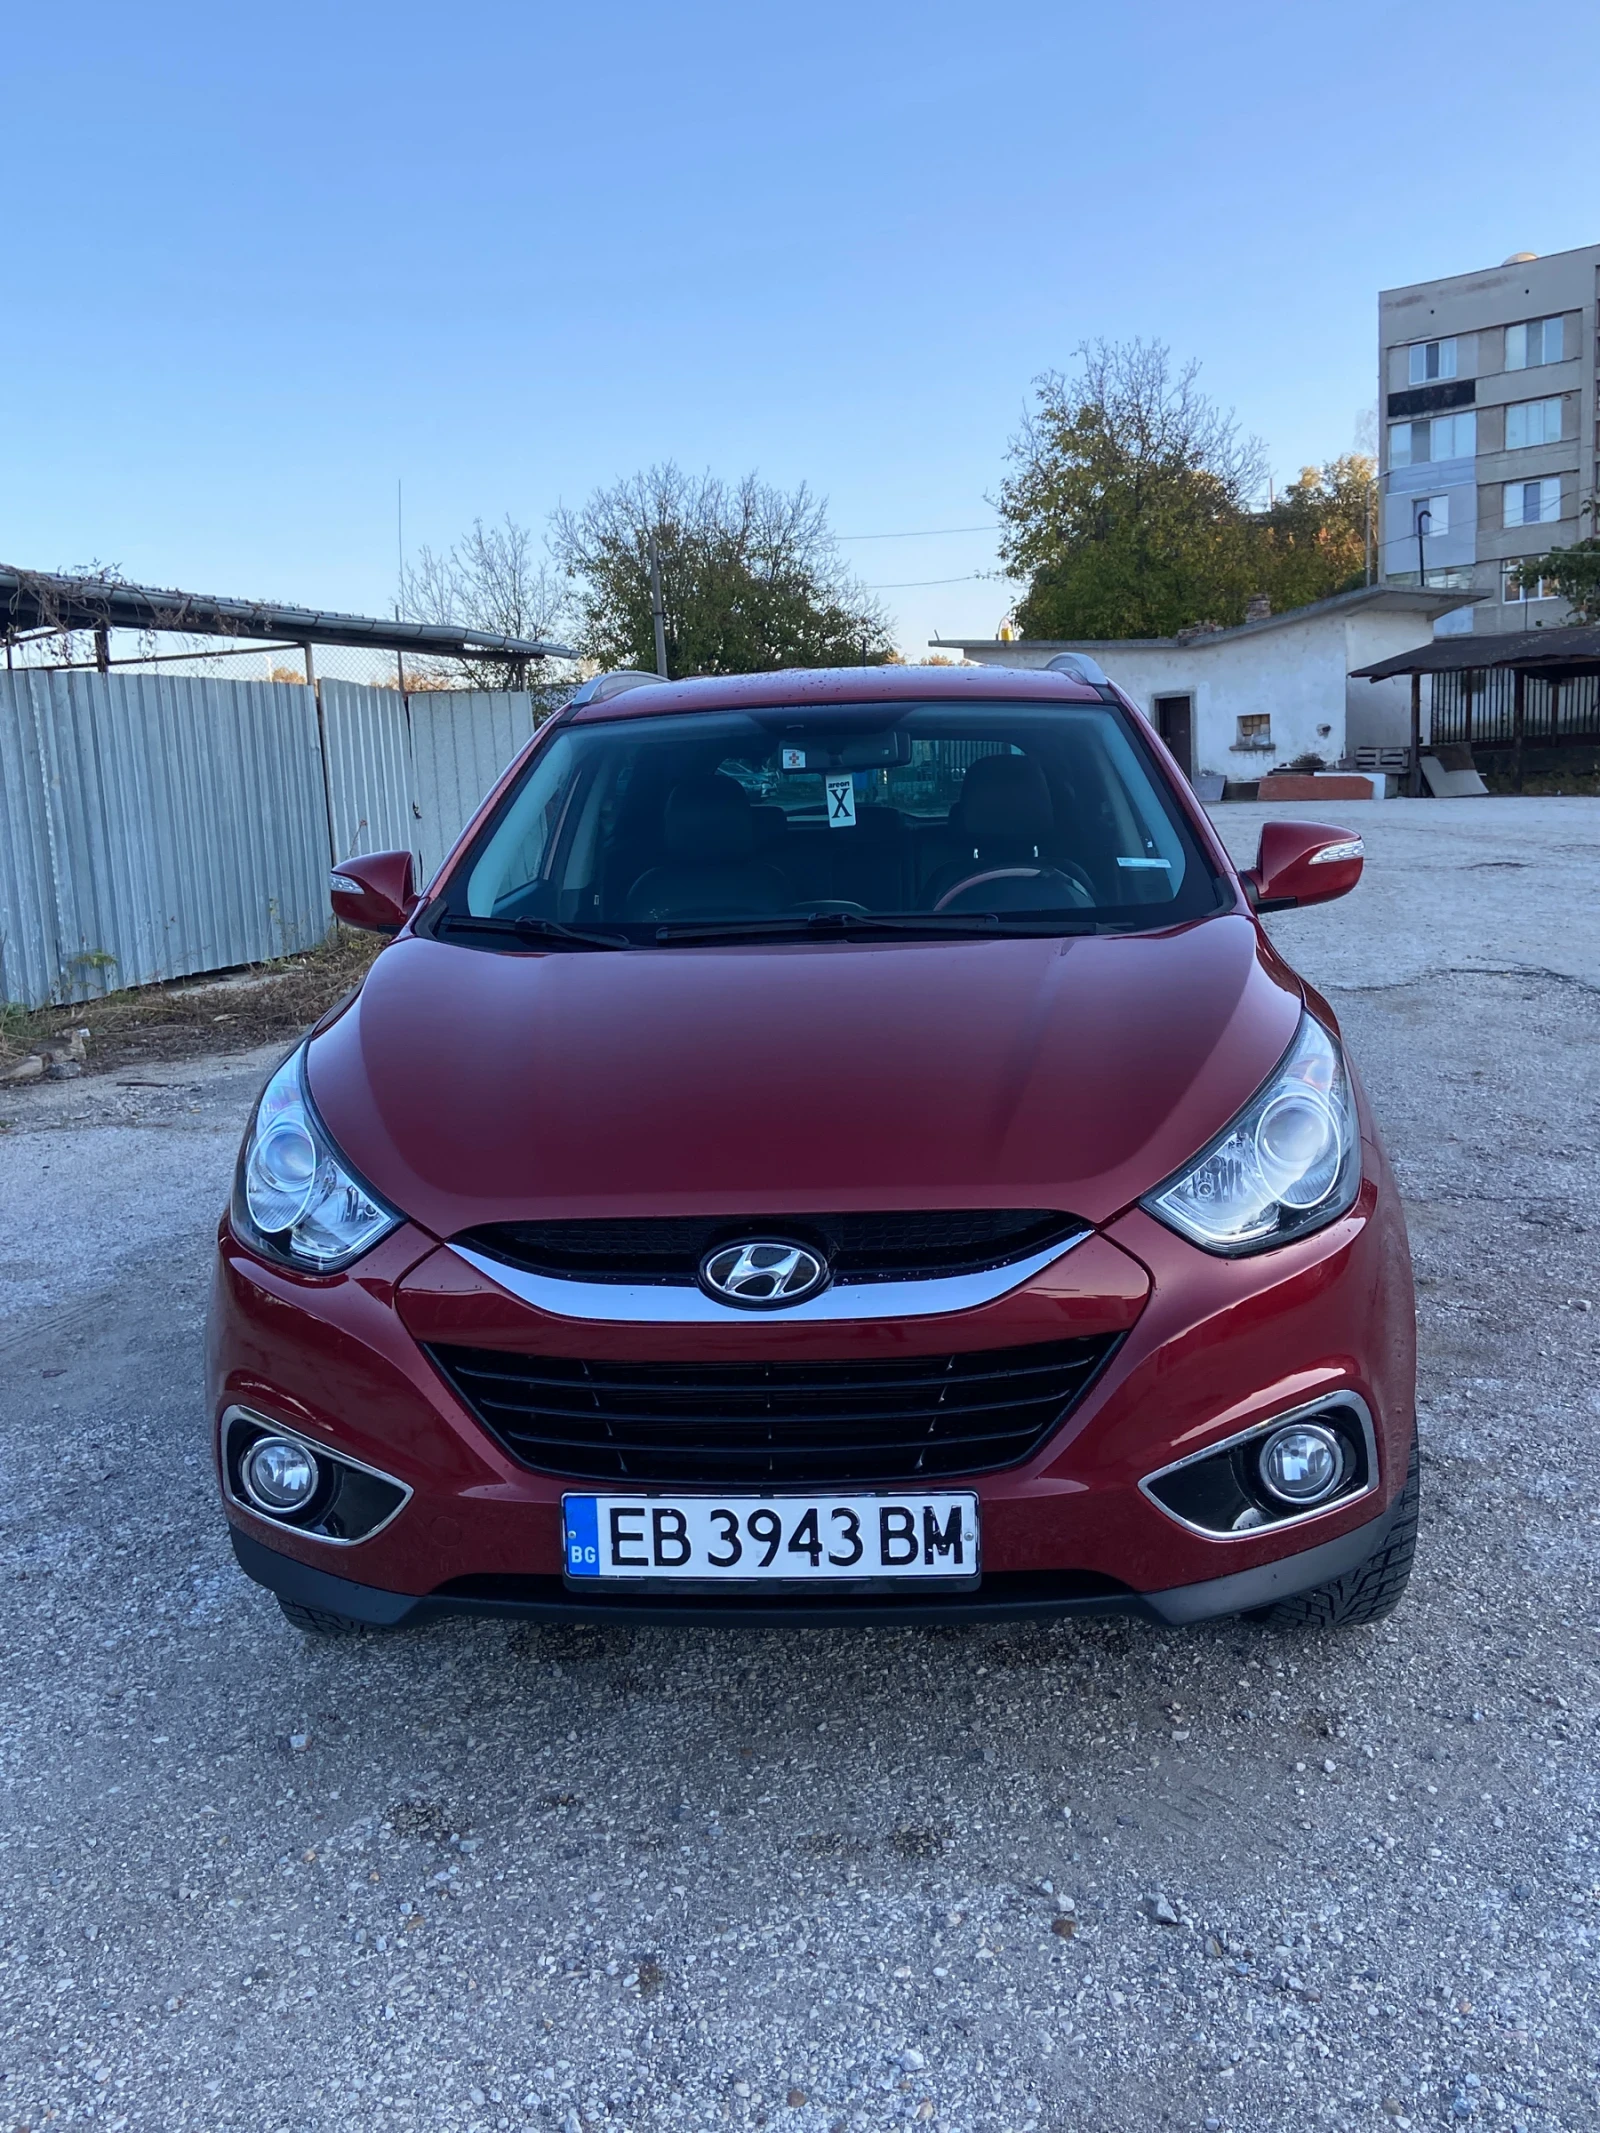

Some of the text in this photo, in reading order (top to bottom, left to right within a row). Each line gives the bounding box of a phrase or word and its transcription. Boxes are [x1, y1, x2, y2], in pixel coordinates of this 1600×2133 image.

[829, 788, 852, 818] X
[609, 1505, 964, 1568] EB 3943 BM
[570, 1545, 597, 1564] BG
